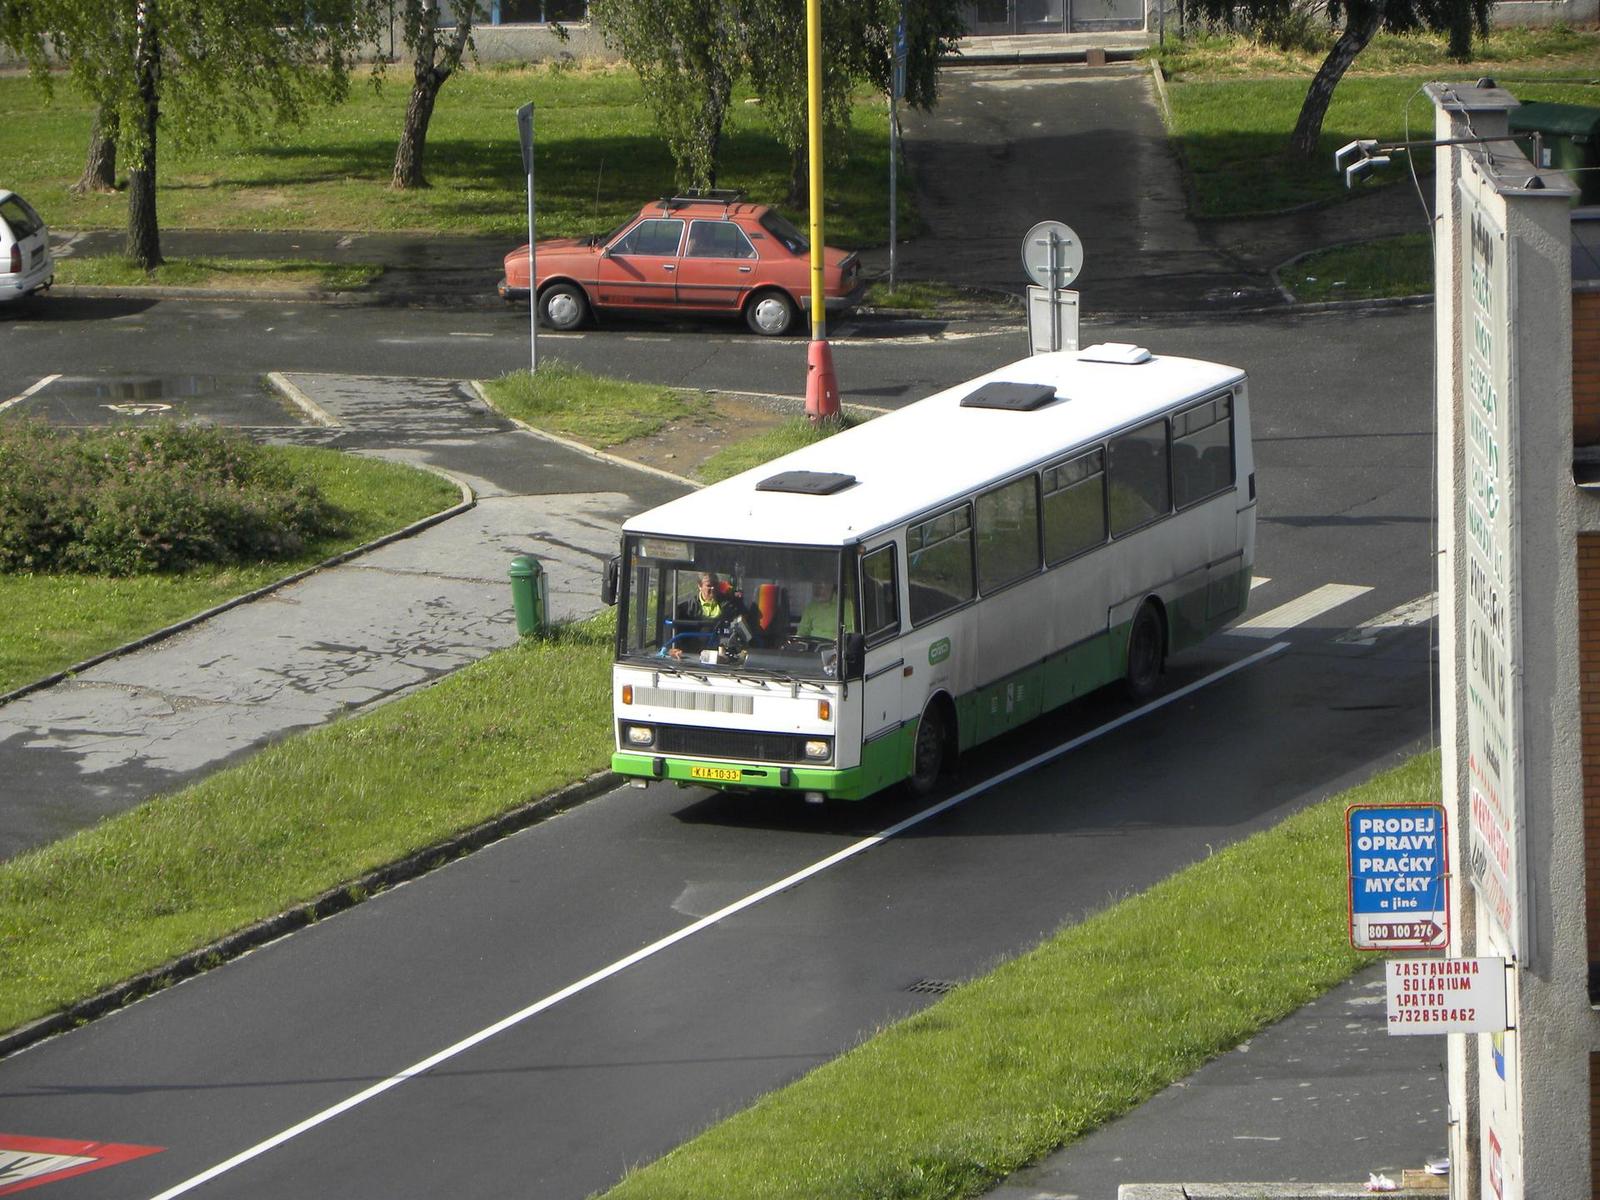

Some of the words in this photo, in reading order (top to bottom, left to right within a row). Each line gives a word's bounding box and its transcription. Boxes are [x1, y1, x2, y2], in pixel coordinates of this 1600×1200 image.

[1360, 818, 1434, 833] PRODEJ
[1357, 835, 1435, 851] OPRAVY
[1359, 853, 1435, 873] PRAČKY
[1365, 873, 1431, 893] MYČKY
[1380, 900, 1389, 908] a
[1392, 897, 1418, 910] jiné
[1369, 925, 1388, 938] 800
[1392, 925, 1411, 938] 100
[1413, 924, 1433, 938] 276
[1403, 975, 1471, 991] SOLÁRIUM
[1398, 1008, 1475, 1022] 732858462
